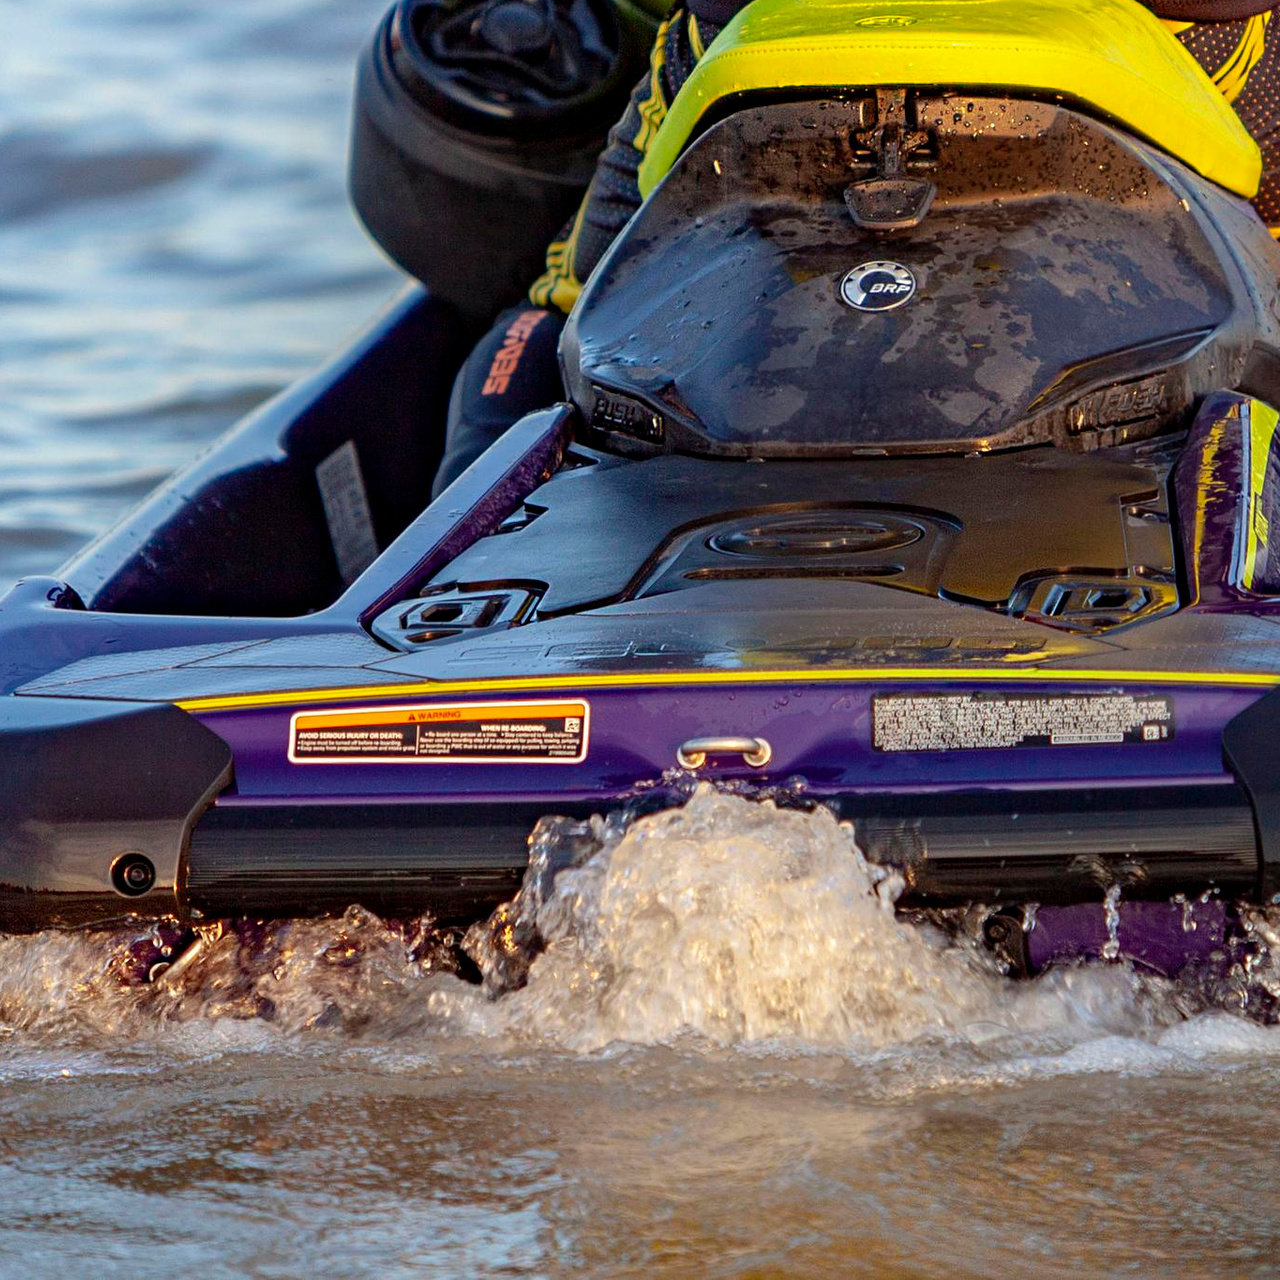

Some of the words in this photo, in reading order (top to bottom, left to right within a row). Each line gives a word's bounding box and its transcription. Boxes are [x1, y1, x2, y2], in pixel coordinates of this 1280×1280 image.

[869, 282, 911, 294] BRP
[418, 710, 461, 720] WARNING
[481, 724, 501, 732] WHEN
[299, 732, 319, 740] AVOID
[319, 732, 346, 740] SERIOUS
[346, 732, 369, 740] INJURY
